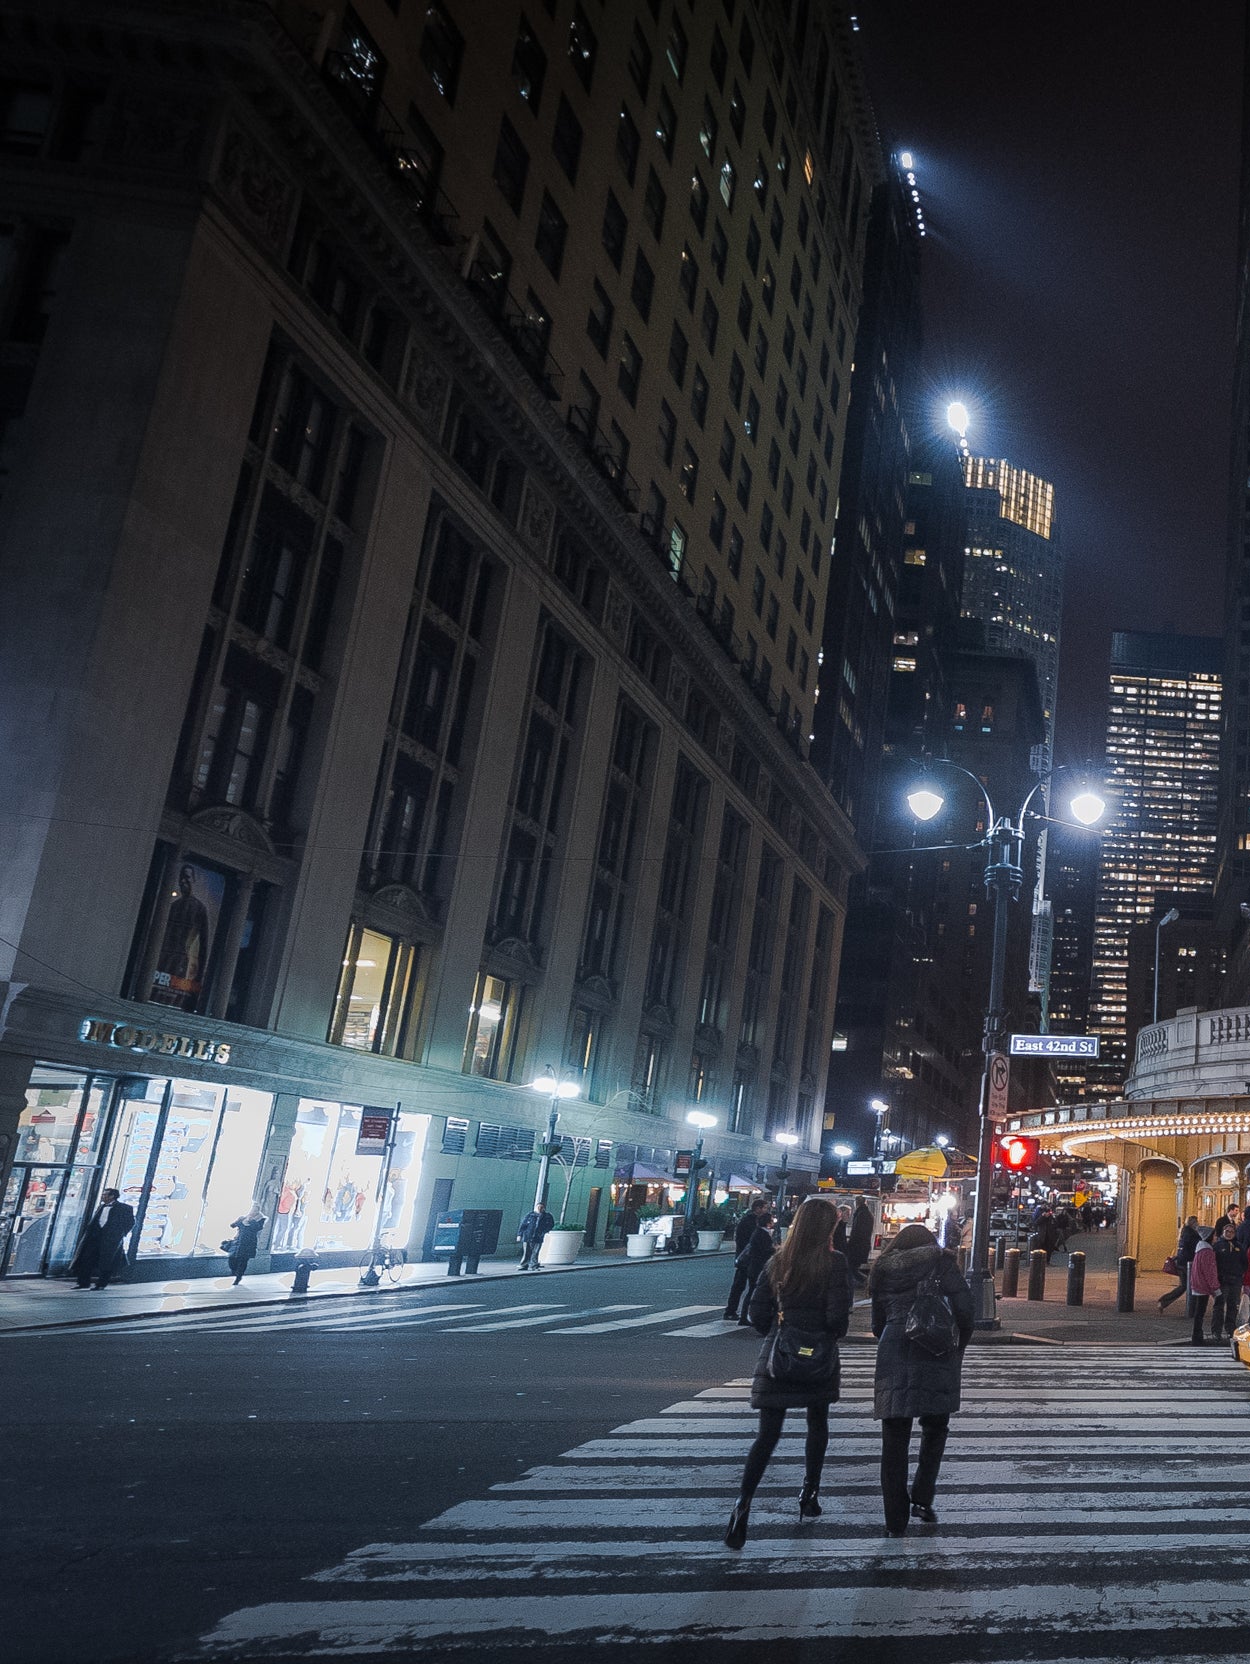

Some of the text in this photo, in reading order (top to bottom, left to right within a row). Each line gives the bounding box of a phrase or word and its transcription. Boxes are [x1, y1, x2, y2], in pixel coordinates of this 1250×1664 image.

[1015, 1039, 1094, 1053] East 42nd St
